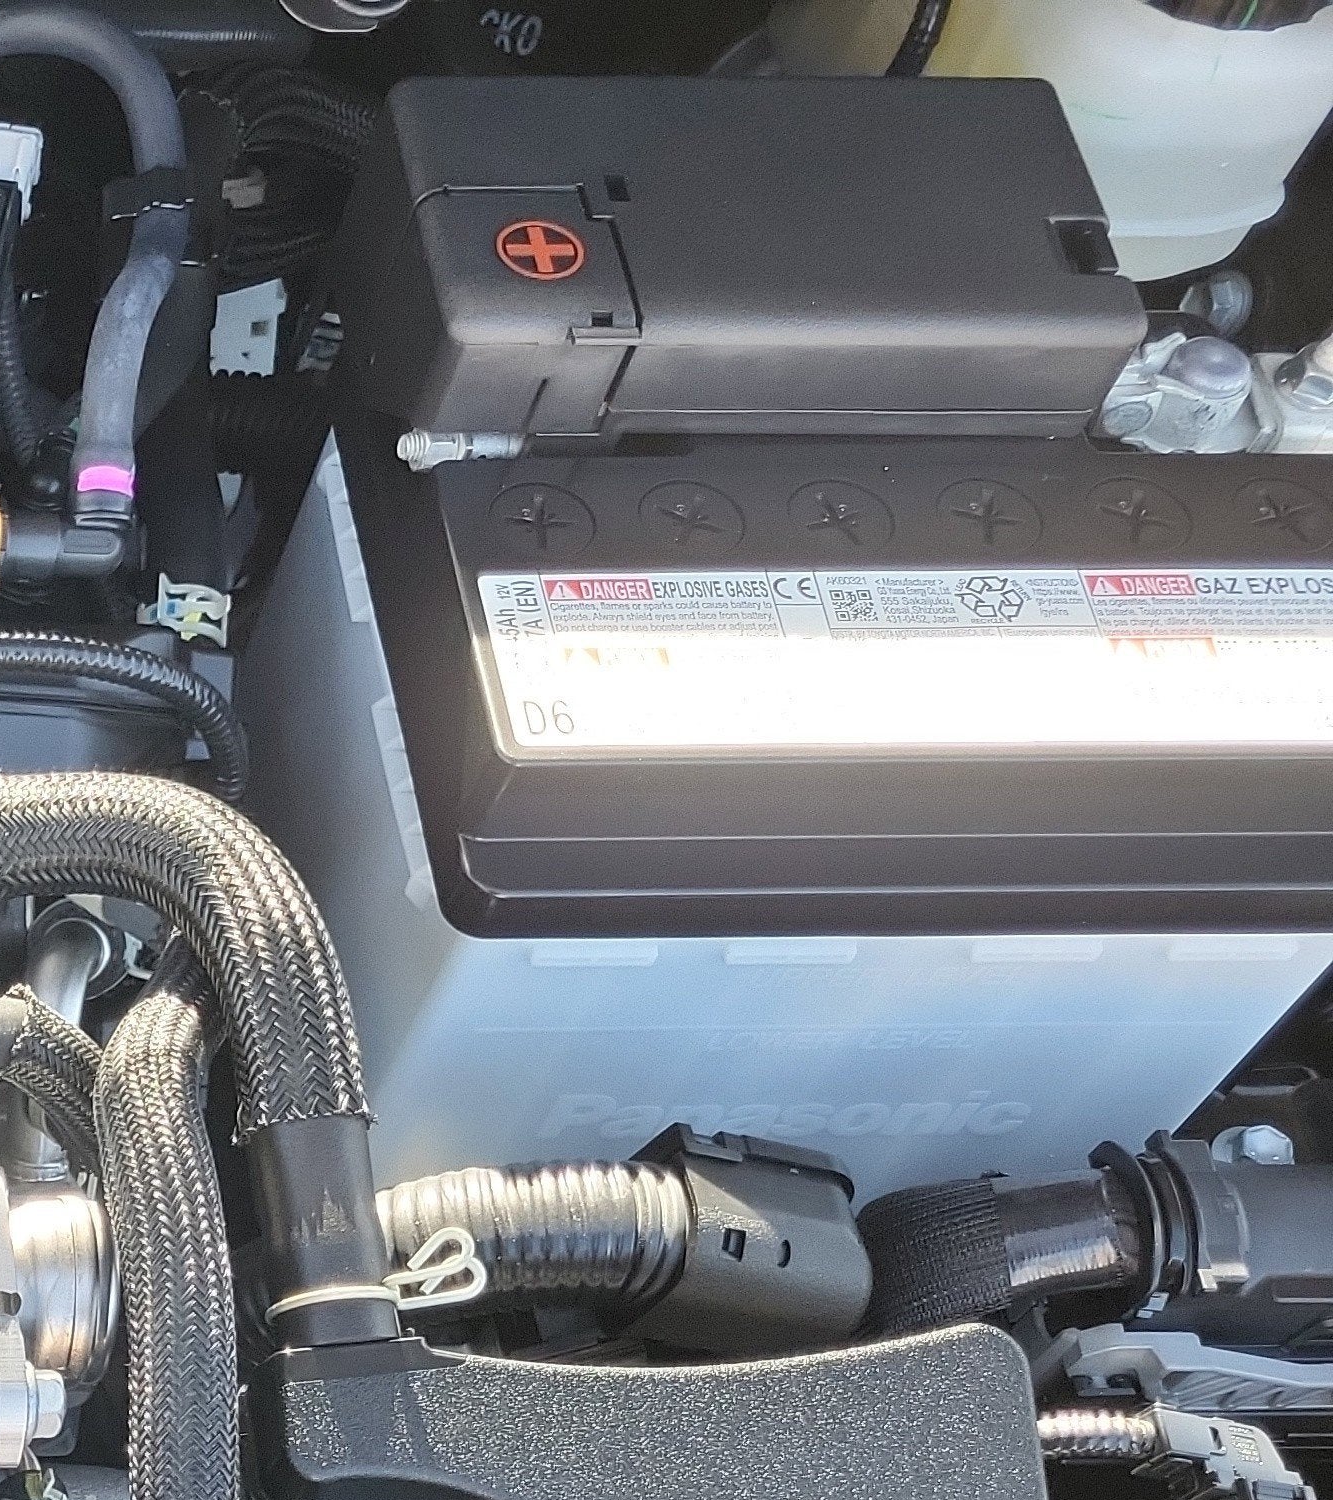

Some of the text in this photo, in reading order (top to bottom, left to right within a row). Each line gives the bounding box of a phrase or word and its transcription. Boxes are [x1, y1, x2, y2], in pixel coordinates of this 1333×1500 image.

[495, 584, 511, 599] 12V
[582, 580, 769, 599] DANGER EXPLOSIVE GASES
[773, 577, 817, 600] CE
[1121, 577, 1192, 595] DANGER
[1195, 577, 1242, 594] GAZ
[510, 581, 541, 613] (EN)
[881, 596, 954, 607] 555 Sakaijuku,
[550, 601, 772, 613] Cigarettes, flames or sparks could cause battery to
[932, 615, 959, 625] Japan
[523, 700, 574, 734] D6
[707, 1029, 974, 1051] LOWER LEVEL
[537, 1090, 1033, 1139] Panasonic
